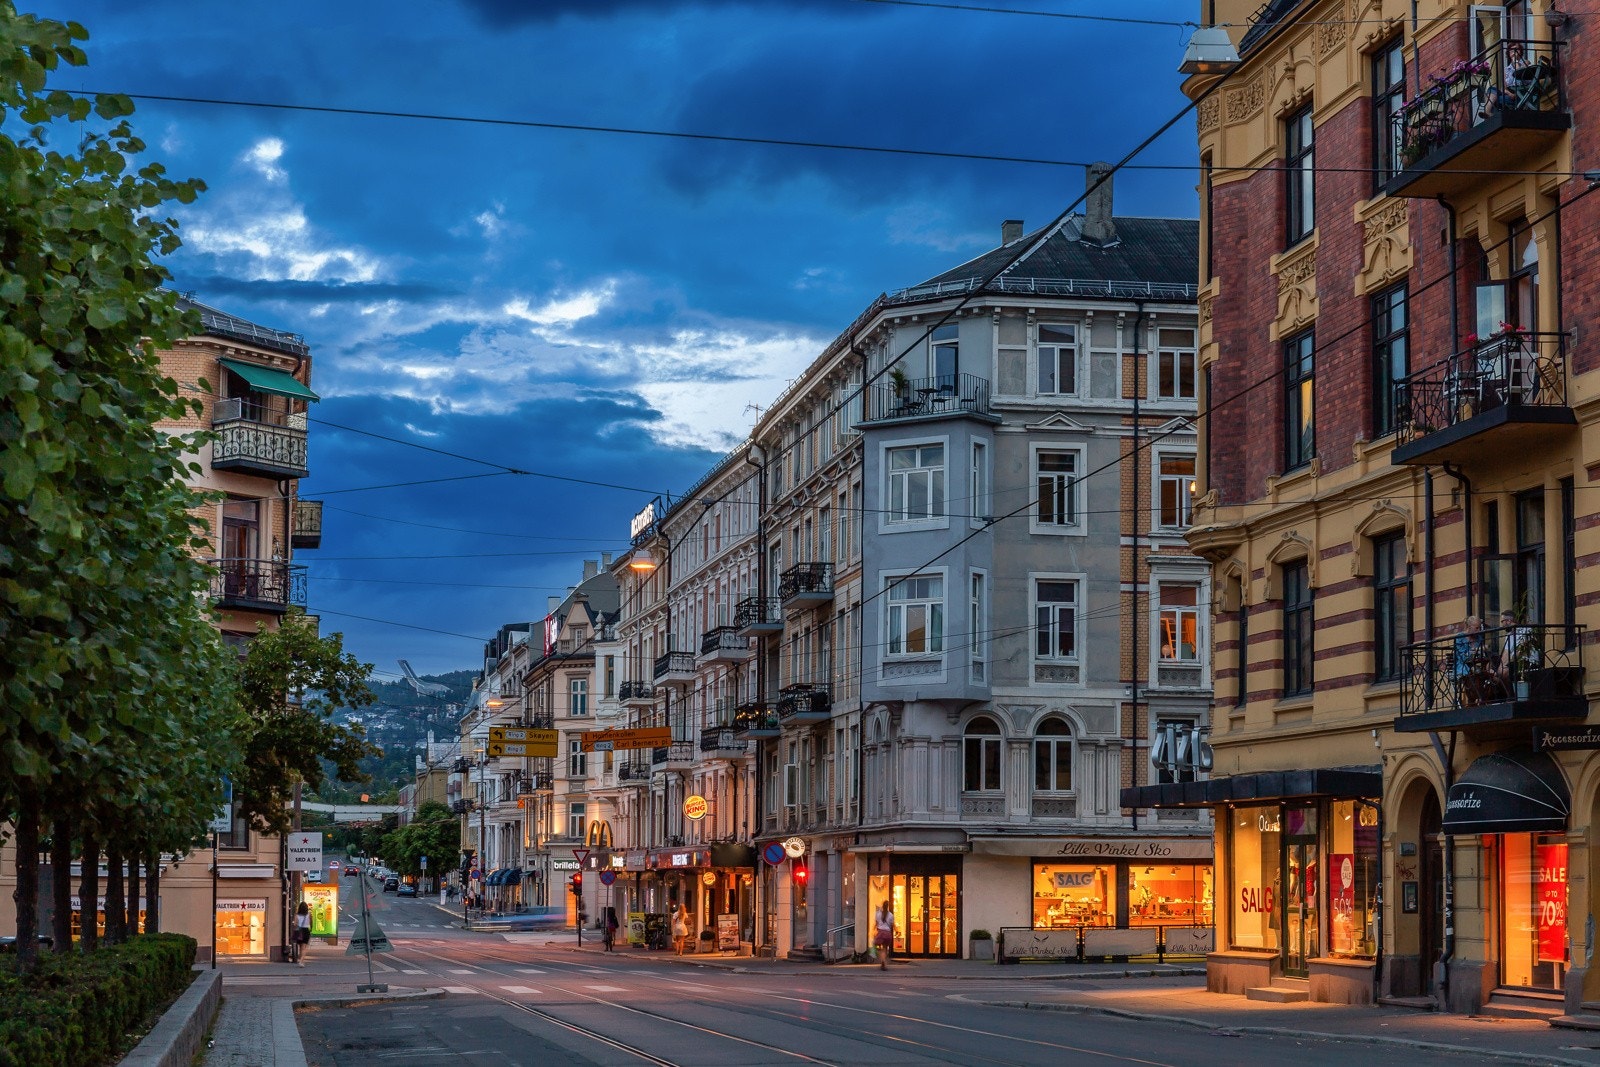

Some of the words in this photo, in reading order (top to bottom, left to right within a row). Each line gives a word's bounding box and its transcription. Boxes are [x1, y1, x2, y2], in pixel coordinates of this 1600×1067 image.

[529, 732, 554, 741] Skøyen
[632, 739, 659, 747] Berners
[686, 804, 705, 815] KING
[1057, 843, 1090, 856] Lille
[1094, 843, 1140, 856] Vinkel
[1143, 843, 1171, 856] Sko
[1057, 874, 1092, 886] SALG
[1540, 867, 1565, 882] SALE
[1241, 887, 1273, 913] SALG
[1011, 946, 1026, 955] Lille
[1030, 946, 1056, 955] Vinkel
[1170, 944, 1187, 952] Lille
